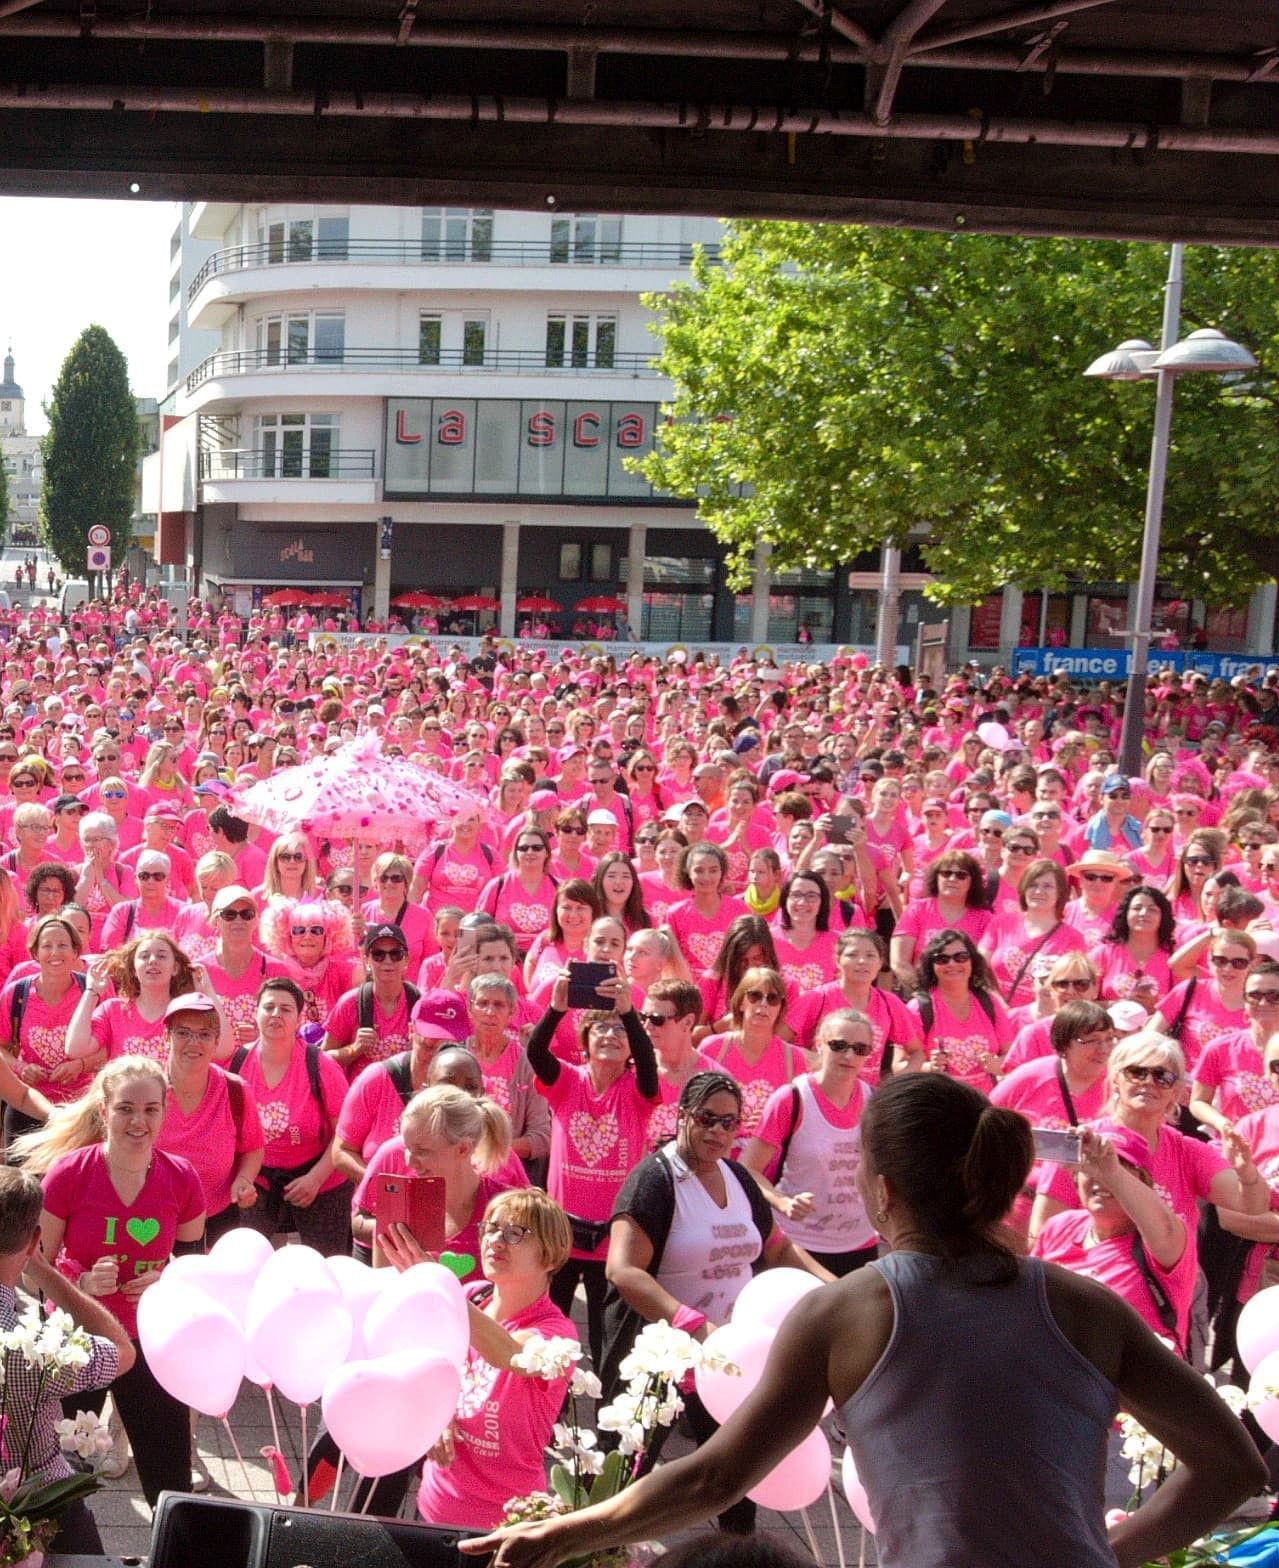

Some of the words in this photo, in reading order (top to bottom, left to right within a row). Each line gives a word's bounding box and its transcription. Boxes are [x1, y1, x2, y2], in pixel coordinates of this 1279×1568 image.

[396, 409, 466, 445] La
[1043, 652, 1118, 673] france
[1126, 655, 1176, 675] eu
[829, 1160, 858, 1171] SPO
[833, 1176, 856, 1188] AN
[827, 1192, 859, 1205] LOV
[102, 1216, 120, 1246] I
[484, 1400, 500, 1441] 2018
